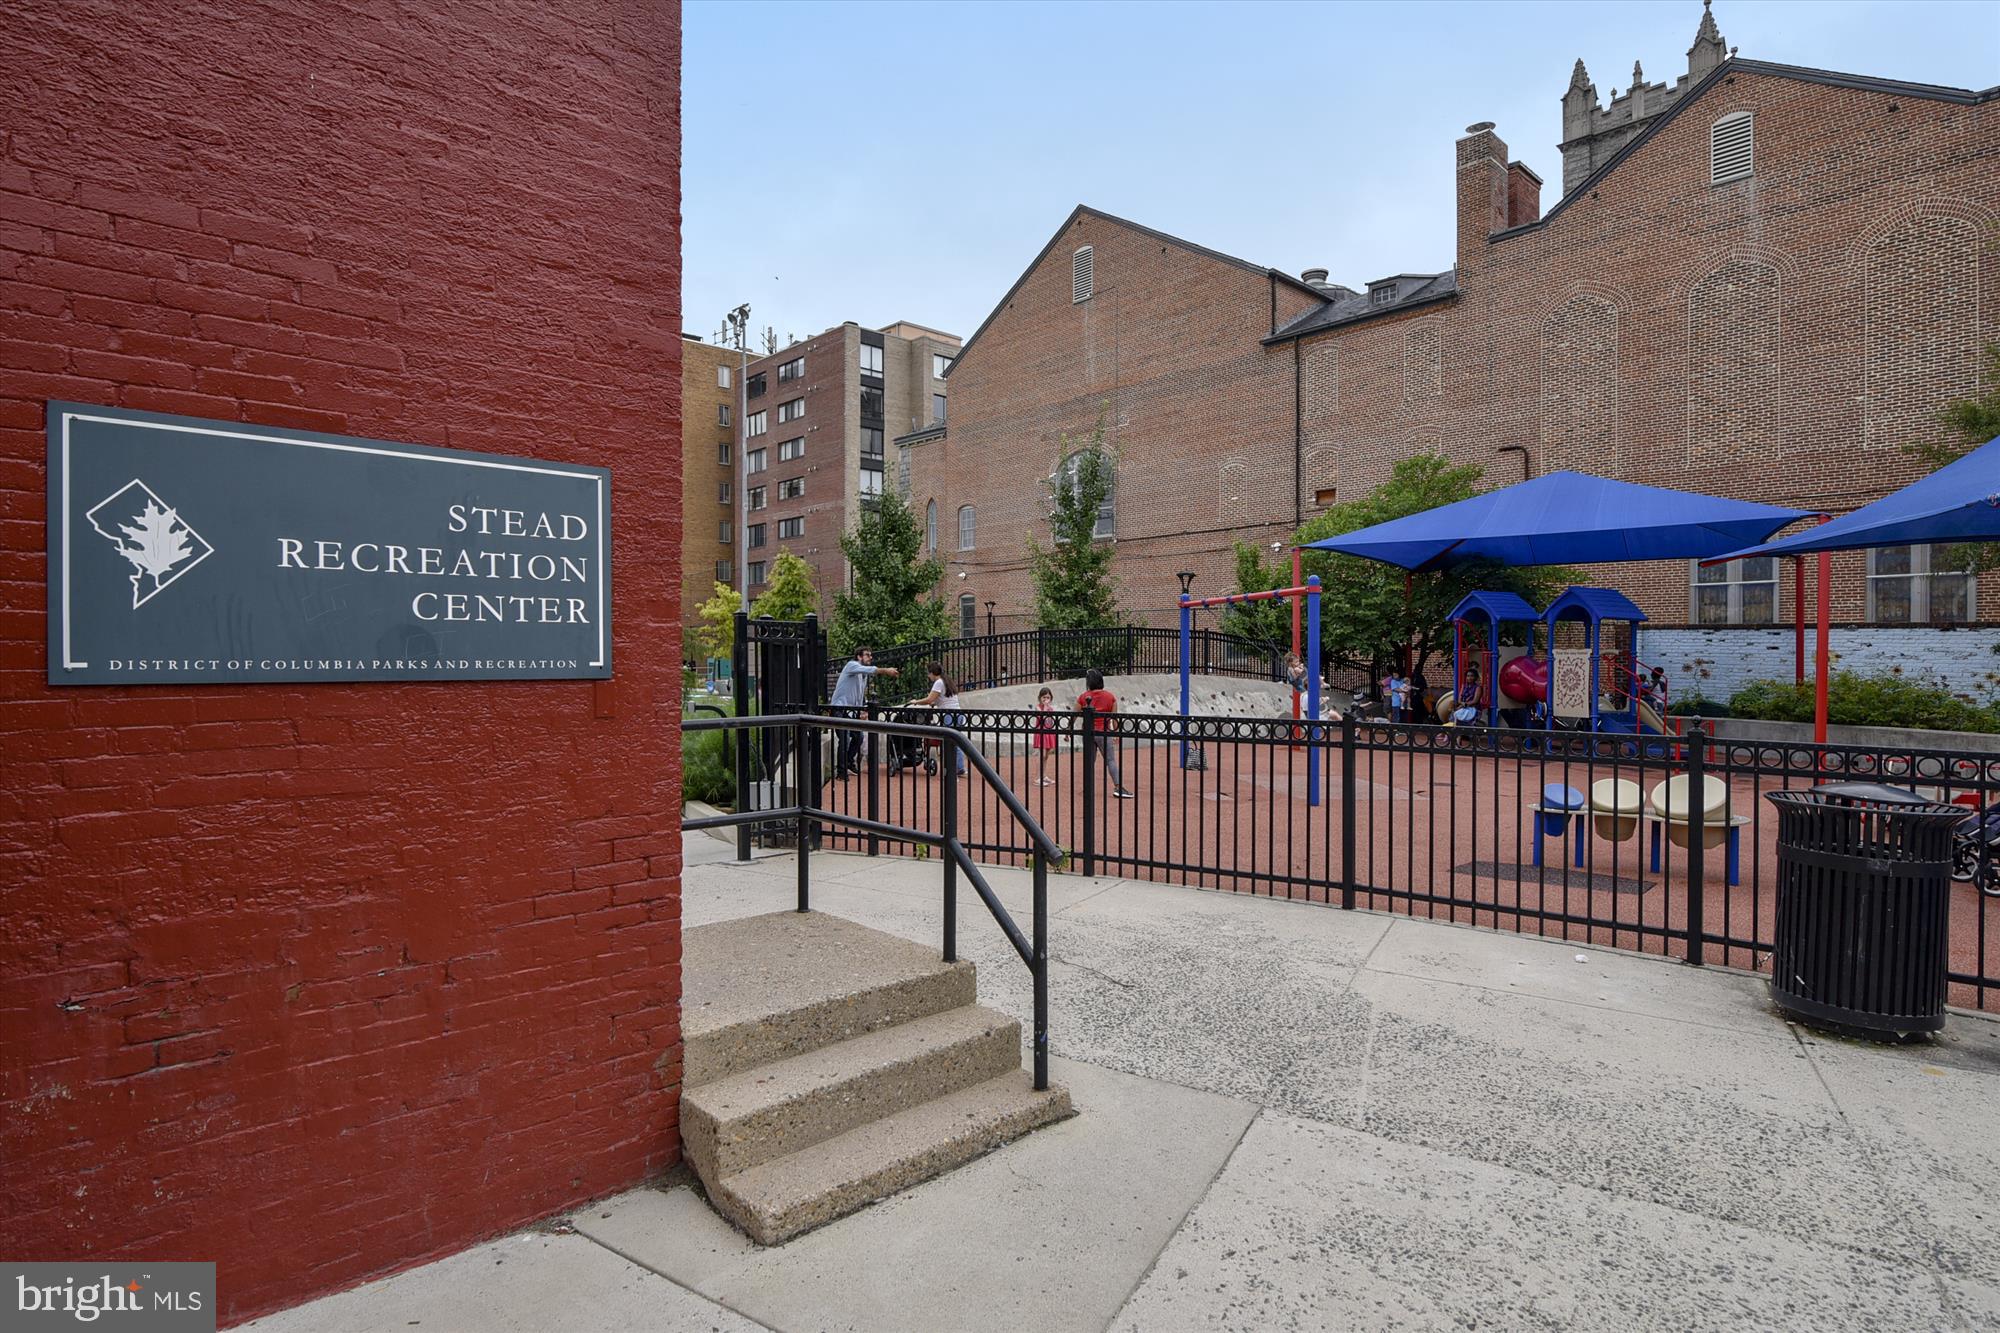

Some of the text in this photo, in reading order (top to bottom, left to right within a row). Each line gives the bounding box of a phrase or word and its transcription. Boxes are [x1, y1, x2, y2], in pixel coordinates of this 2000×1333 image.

[448, 504, 588, 541] STEAD
[277, 537, 588, 583] RECREATION
[412, 592, 590, 624] CENTER
[109, 659, 578, 671] DISTRICT OF COLUMBIA PARKS AND RECREATION
